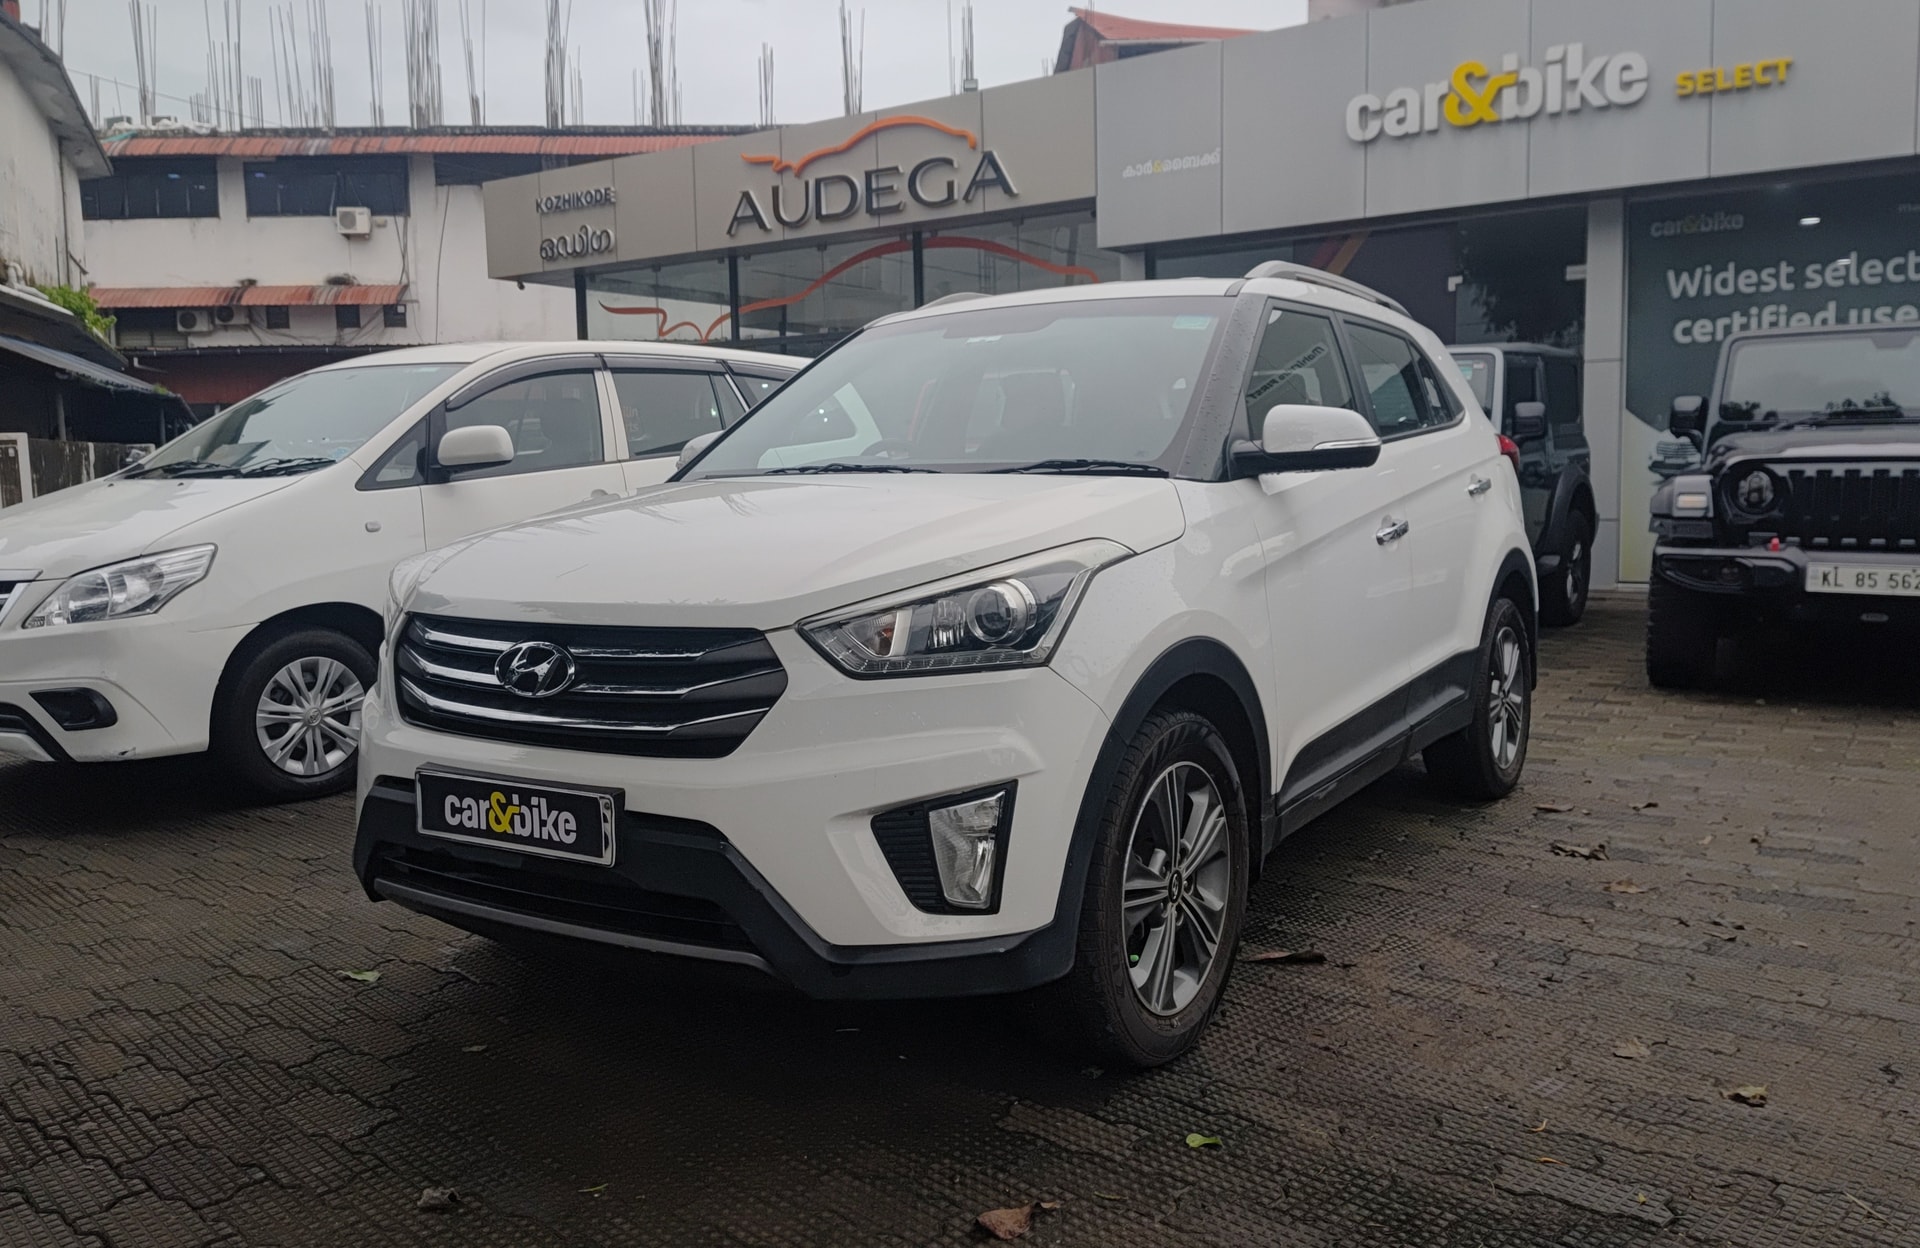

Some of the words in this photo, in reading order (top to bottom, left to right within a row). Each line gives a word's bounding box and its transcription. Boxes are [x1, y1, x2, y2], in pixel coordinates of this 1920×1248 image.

[1345, 43, 1649, 142] car&bike
[1675, 57, 1794, 98] SELECT
[535, 186, 617, 213] KOZHIKODE
[727, 149, 1020, 236] AUDEGA
[1666, 260, 1796, 299] Widest
[1673, 303, 1837, 344] certified
[1821, 568, 1844, 588] KL
[1855, 572, 1879, 589] 85
[444, 791, 578, 844] car&bike
